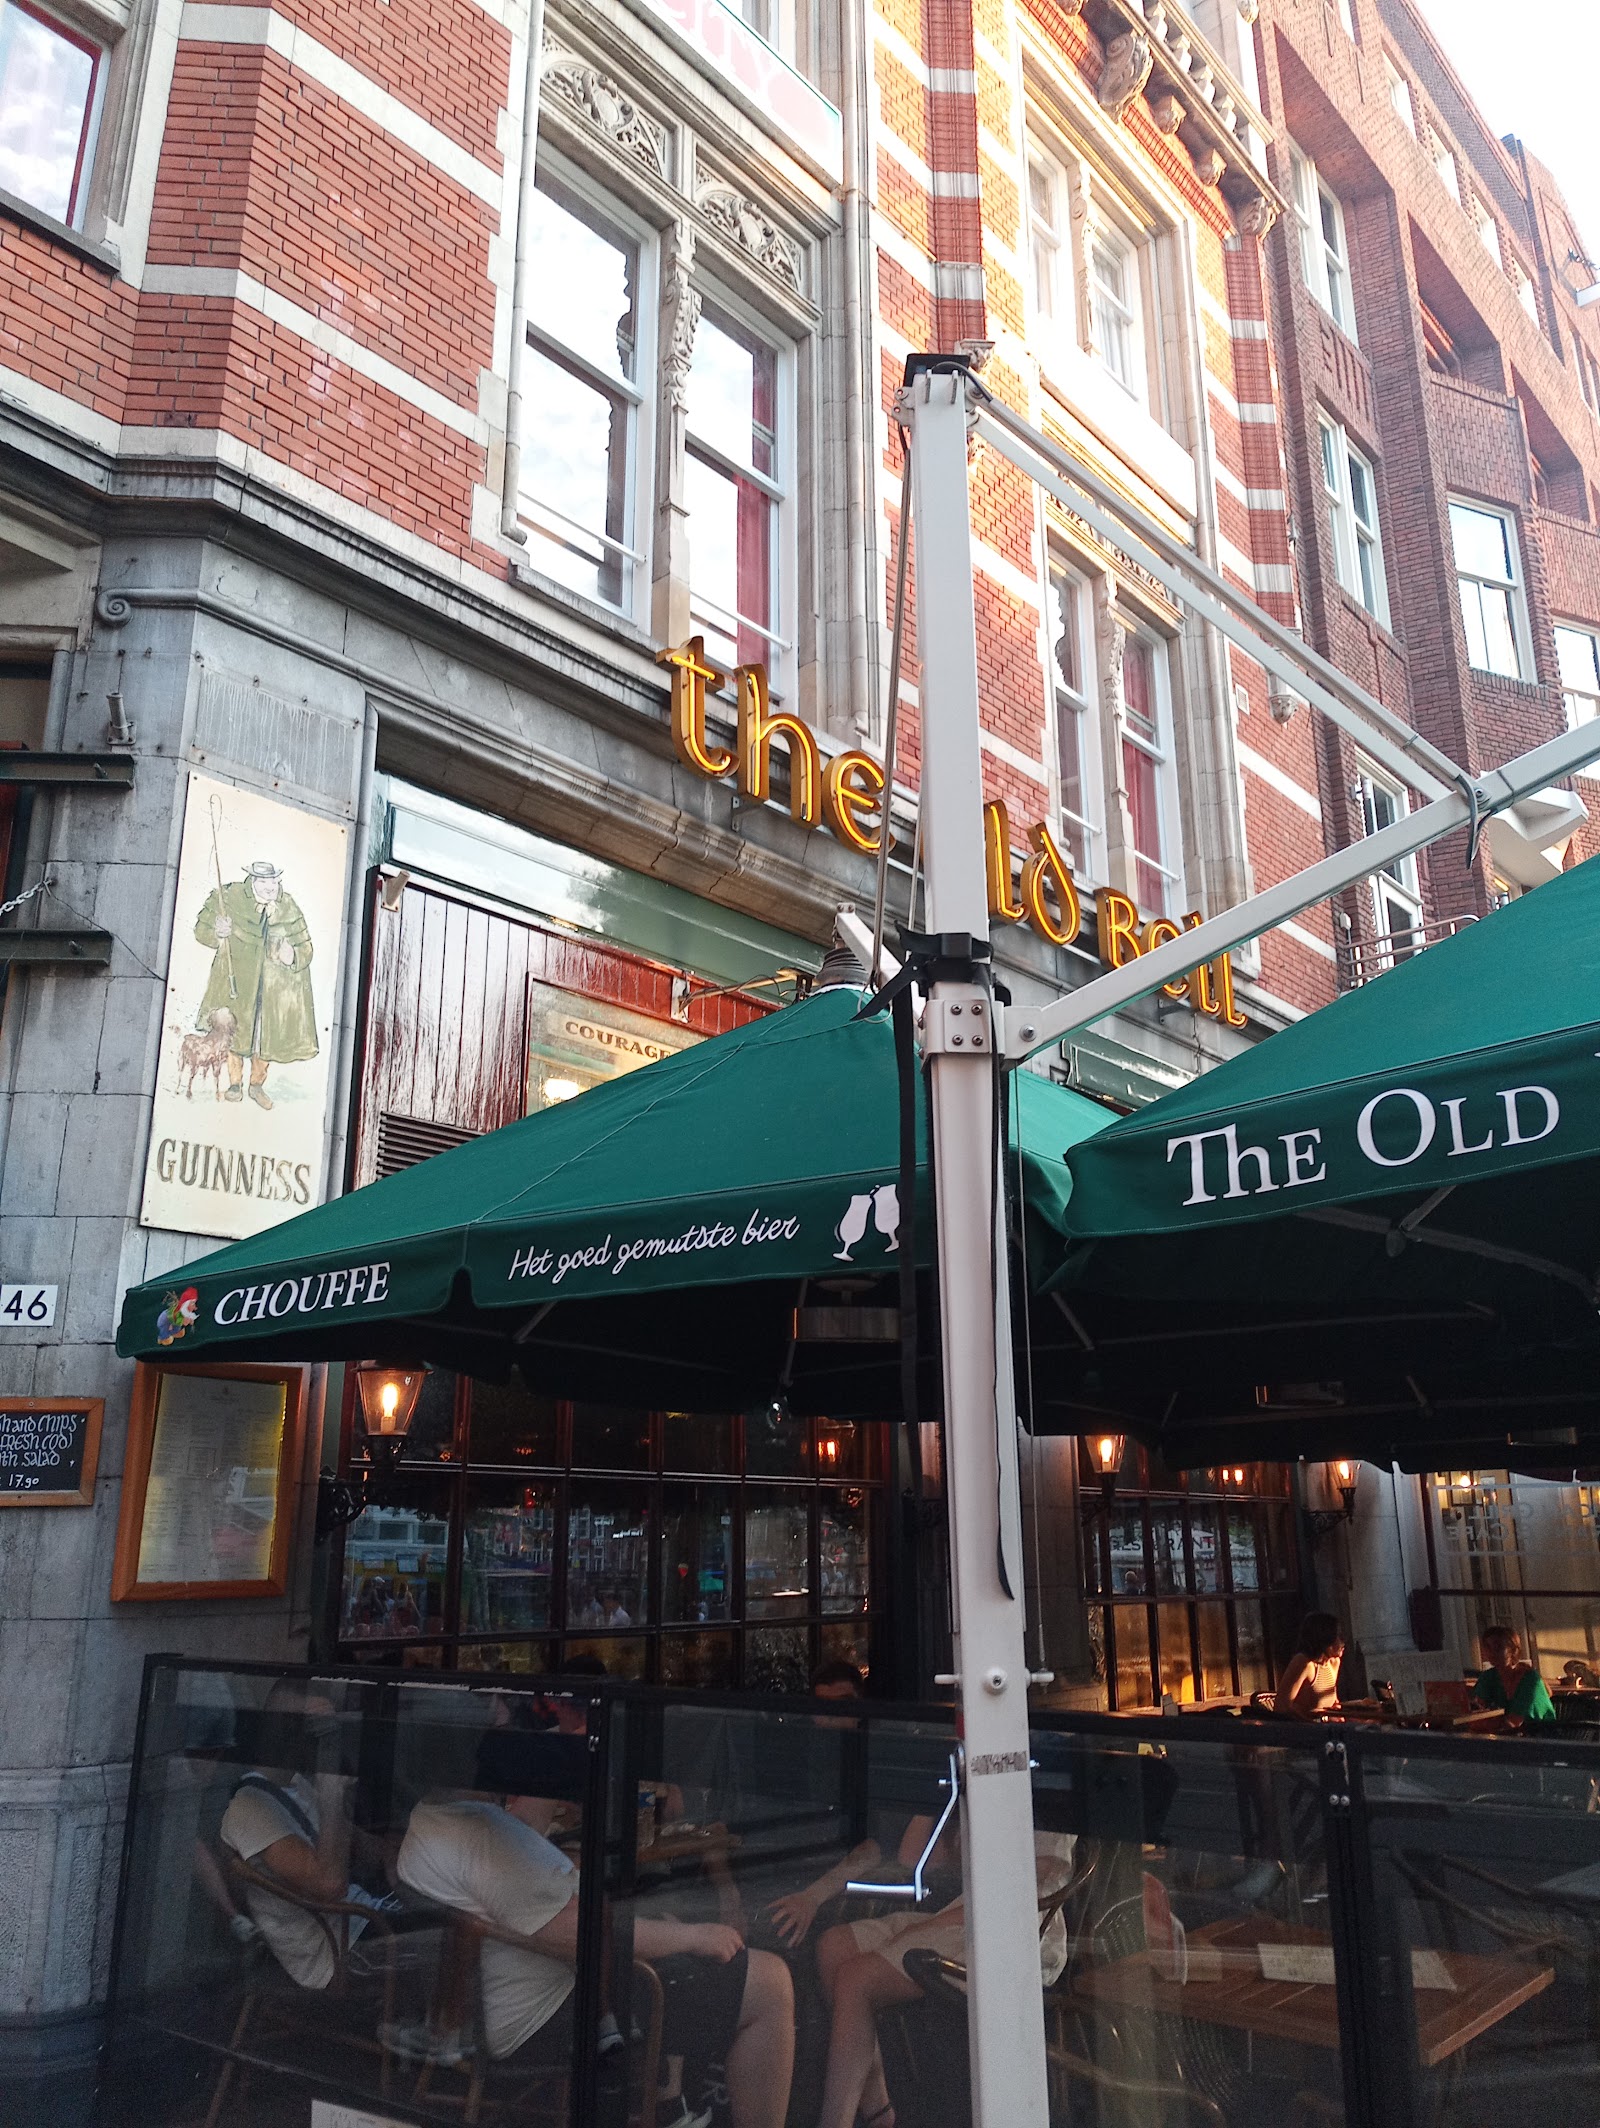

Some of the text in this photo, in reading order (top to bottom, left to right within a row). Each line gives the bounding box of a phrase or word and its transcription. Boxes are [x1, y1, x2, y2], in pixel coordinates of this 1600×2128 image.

[656, 635, 896, 856] the
[984, 799, 1082, 946] ld
[1356, 1085, 1561, 1167] OLD
[156, 1138, 312, 1205] GUINNESS
[508, 1207, 801, 1285] Het goed gemutste bier
[3, 1290, 48, 1321] 46
[213, 1261, 391, 1326] CHOUFFE
